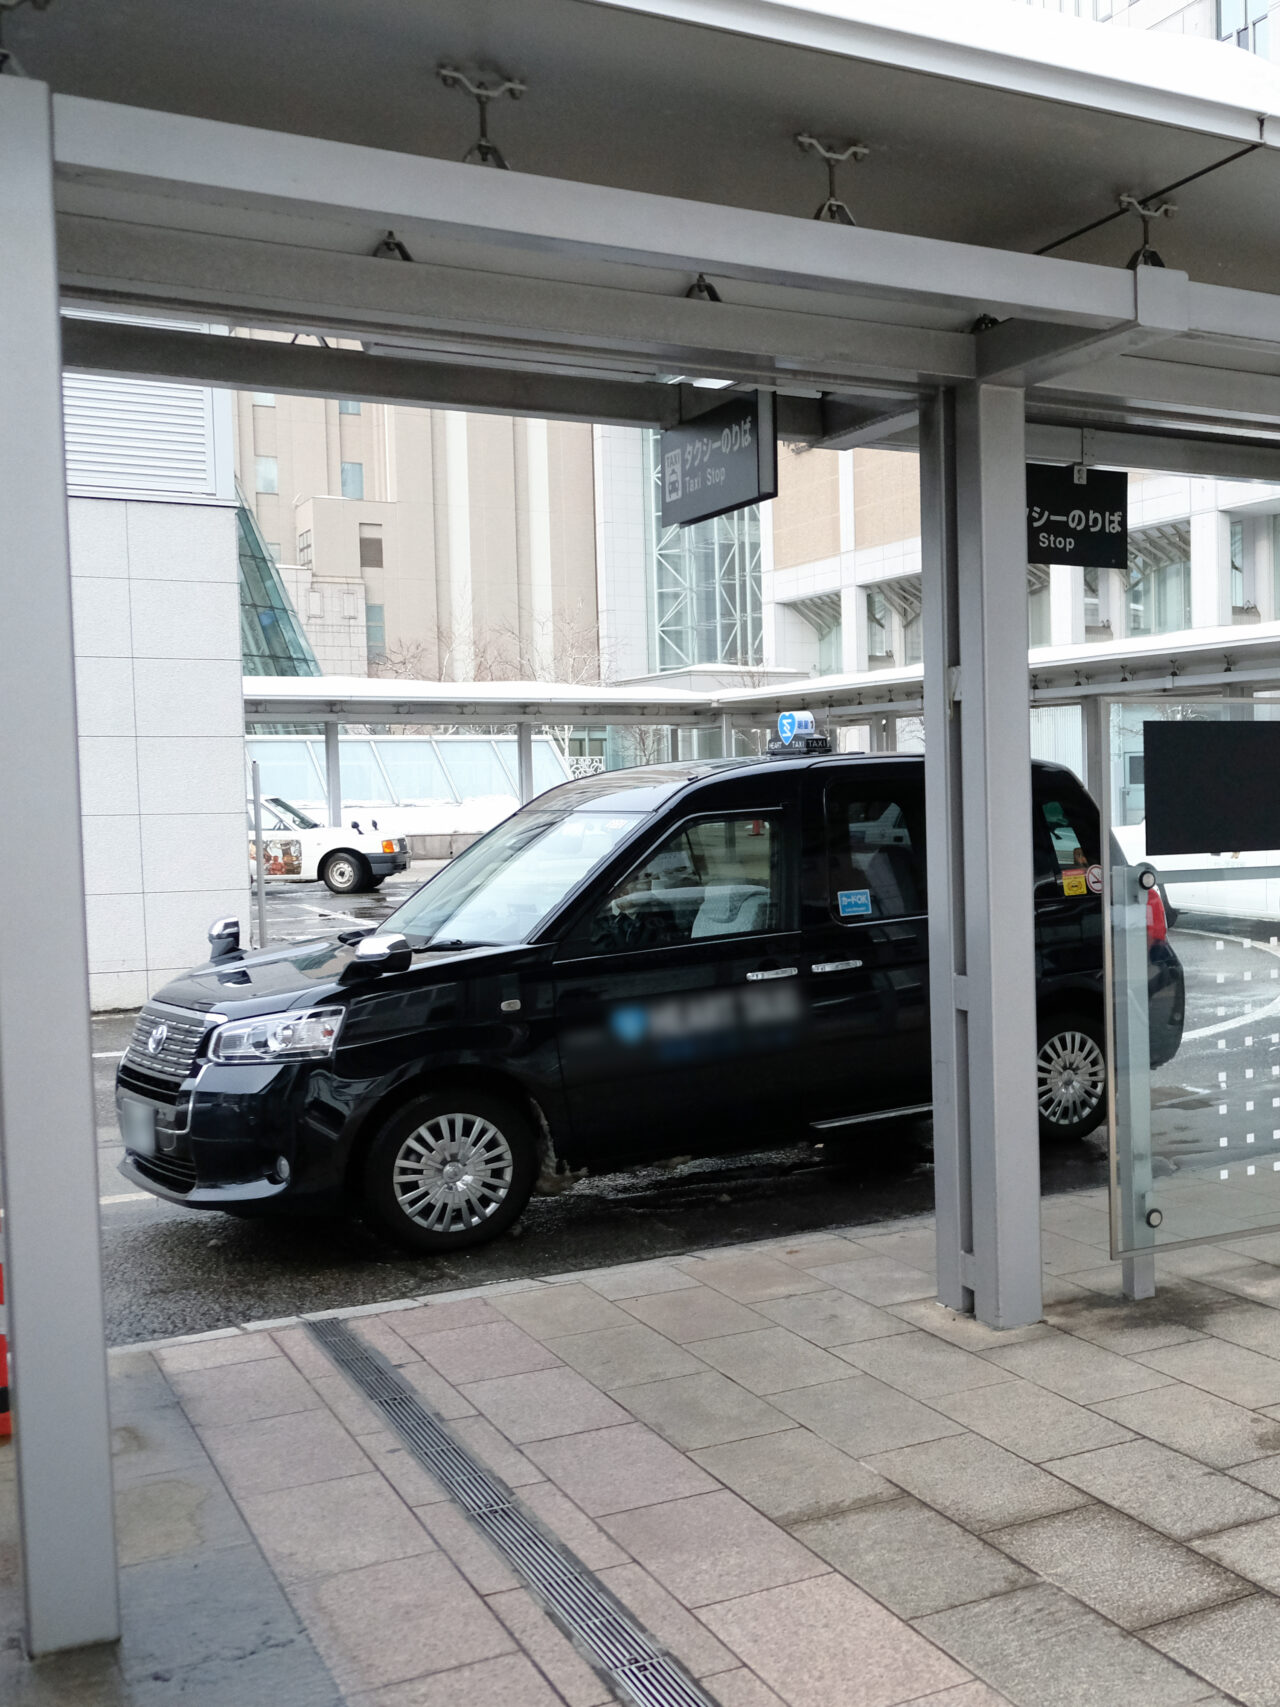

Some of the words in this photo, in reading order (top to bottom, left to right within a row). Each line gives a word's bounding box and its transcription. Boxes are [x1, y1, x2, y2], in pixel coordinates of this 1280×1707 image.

[684, 416, 752, 470] タクシーのりば
[685, 472, 702, 494] Taxi
[706, 467, 726, 487] Stop
[1026, 506, 1123, 534] シーのりば
[1039, 532, 1075, 552] Stop
[792, 740, 805, 748] TAXI
[807, 739, 827, 749] TAXI
